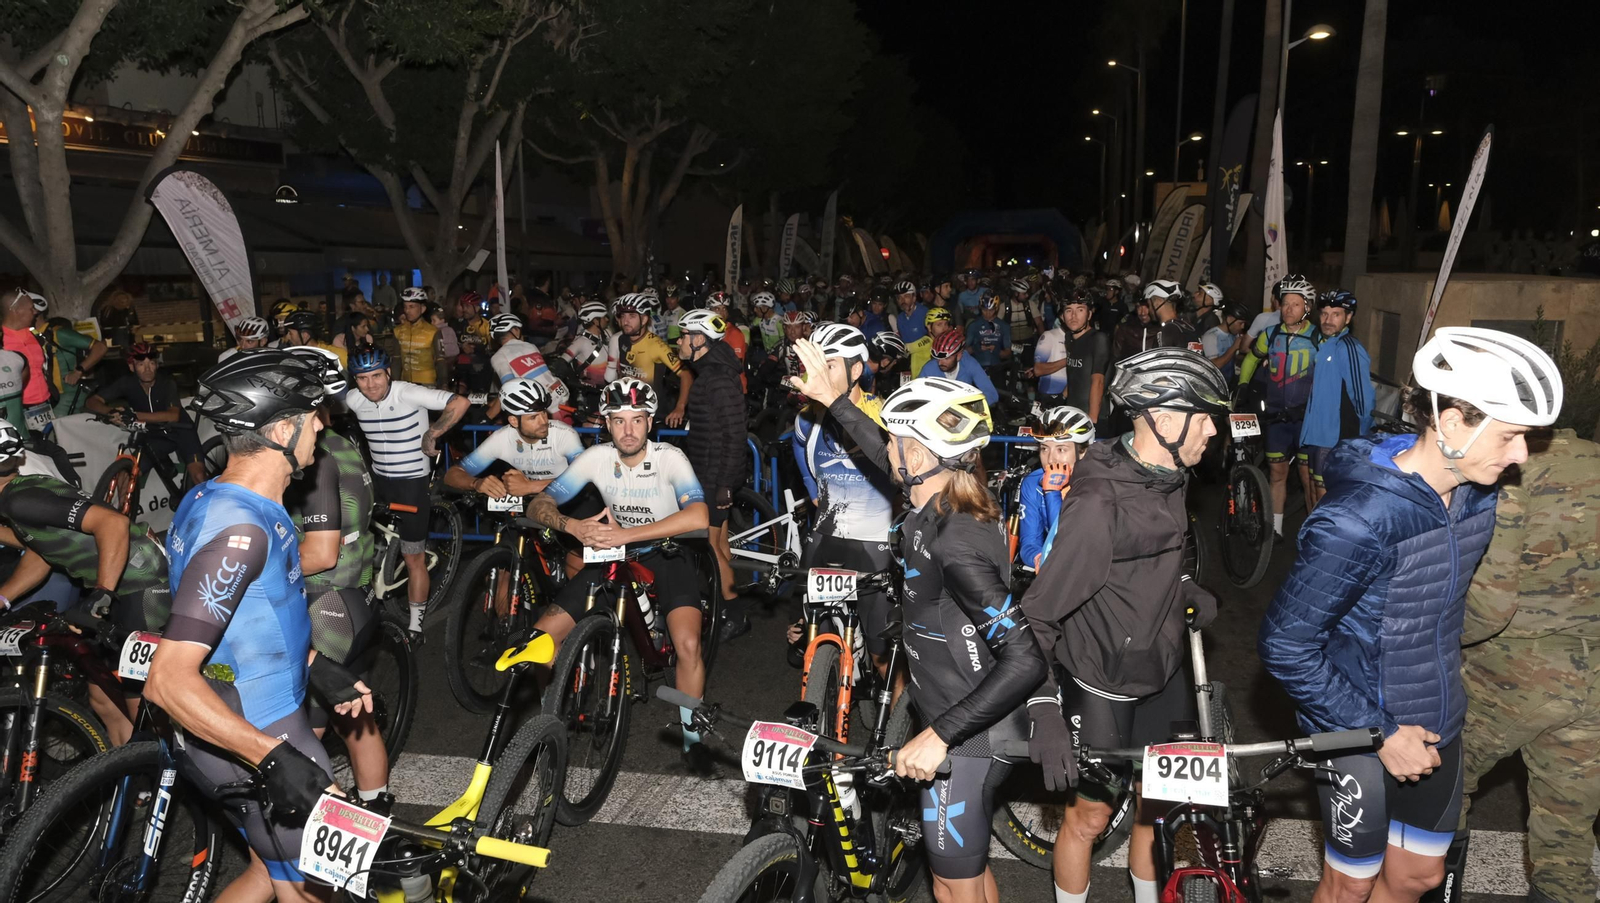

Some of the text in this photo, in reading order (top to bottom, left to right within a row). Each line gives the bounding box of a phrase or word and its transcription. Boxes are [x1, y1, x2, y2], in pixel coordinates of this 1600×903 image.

[887, 418, 918, 427] SCOTT
[1235, 421, 1257, 432] 8294
[149, 495, 169, 513] de
[211, 556, 240, 597] CCC
[816, 575, 854, 592] 9104
[977, 612, 1006, 631] OXYGEN
[965, 639, 983, 673] ATIKA
[71, 712, 109, 754] SCORPIO
[19, 749, 38, 783] FOX
[752, 740, 804, 774] 9114
[1157, 755, 1222, 783] 9204
[764, 775, 793, 786] cajamar
[325, 803, 337, 815] LA
[937, 779, 949, 851] OXYGEN BIKE
[313, 825, 371, 874] 8941
[1008, 820, 1047, 856] MAXXIS
